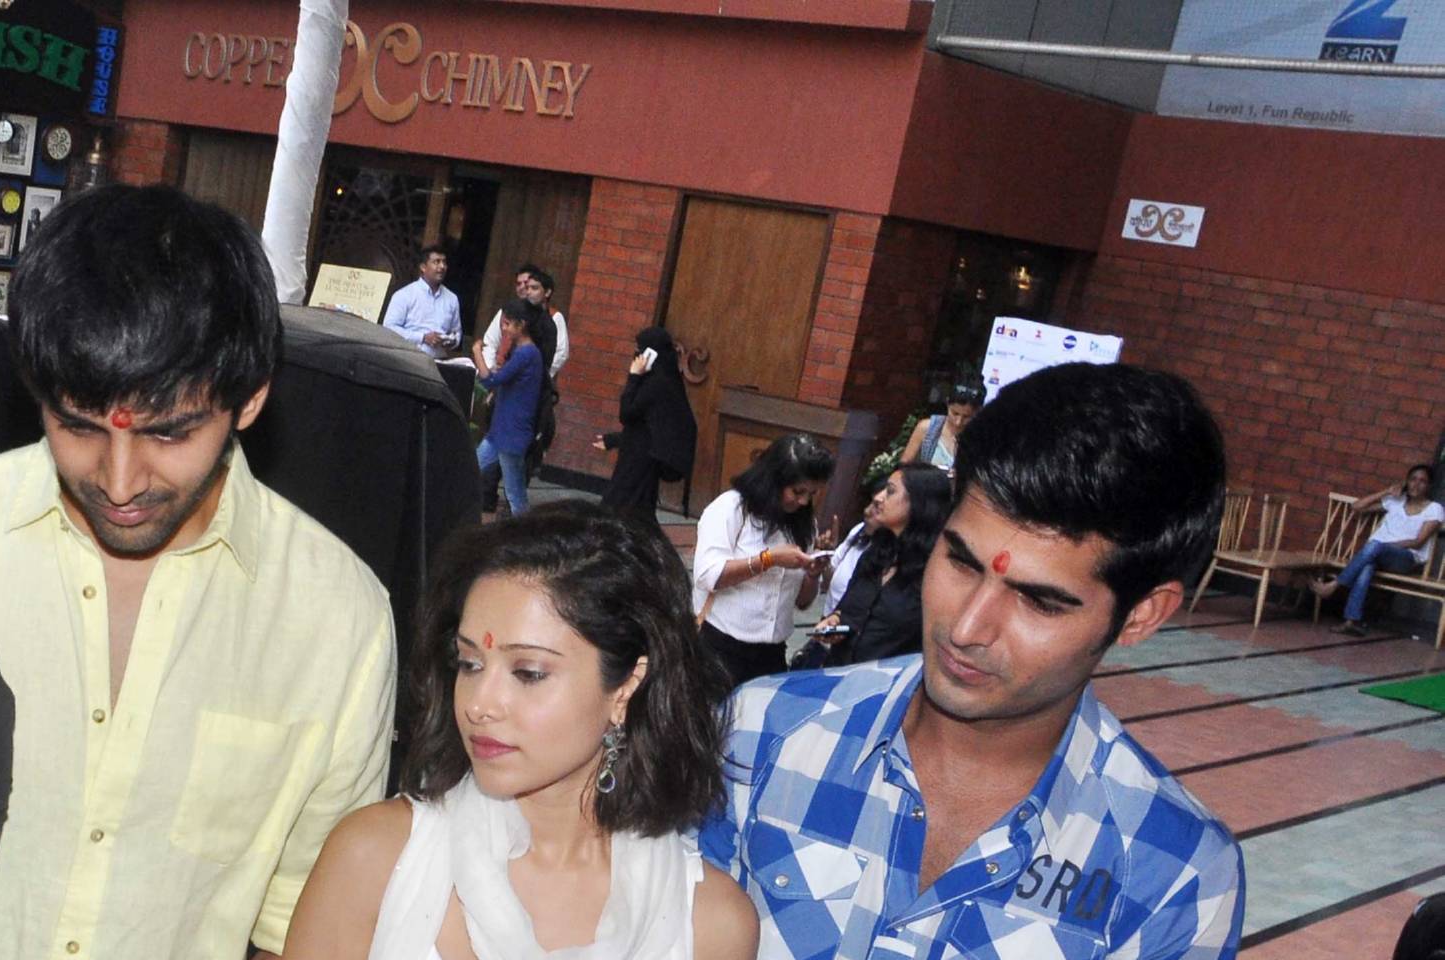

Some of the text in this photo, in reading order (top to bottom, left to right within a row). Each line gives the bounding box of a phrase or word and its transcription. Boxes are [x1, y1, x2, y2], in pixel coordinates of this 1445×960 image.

[185, 32, 297, 87] COPPE
[420, 51, 591, 117] CHIMNEY
[1207, 101, 1243, 115] Level
[1262, 105, 1289, 118] Fun
[1292, 107, 1354, 124] Republic
